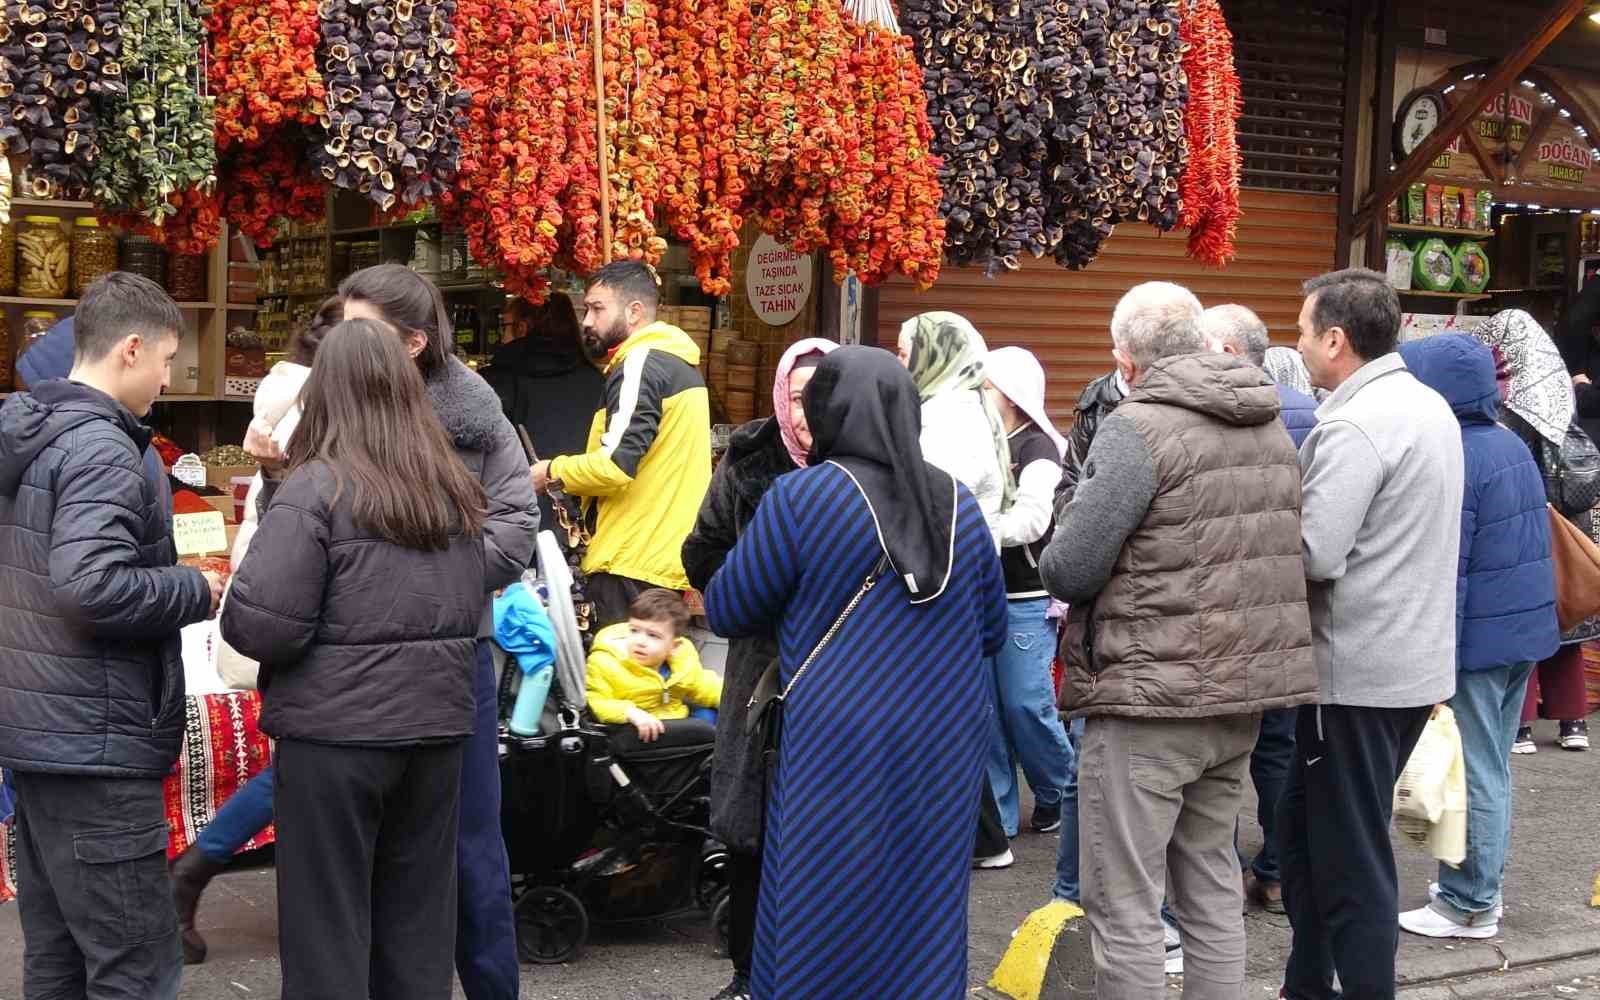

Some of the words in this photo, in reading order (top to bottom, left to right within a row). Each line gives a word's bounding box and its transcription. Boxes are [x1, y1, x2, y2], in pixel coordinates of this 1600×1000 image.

[1539, 138, 1591, 168] DOĞAN
[1549, 166, 1585, 184] BAHARAT
[761, 265, 797, 279] TAŞINDA
[755, 285, 776, 297] TAZE
[777, 282, 804, 295] SICAK
[760, 295, 796, 313] TAHİN
